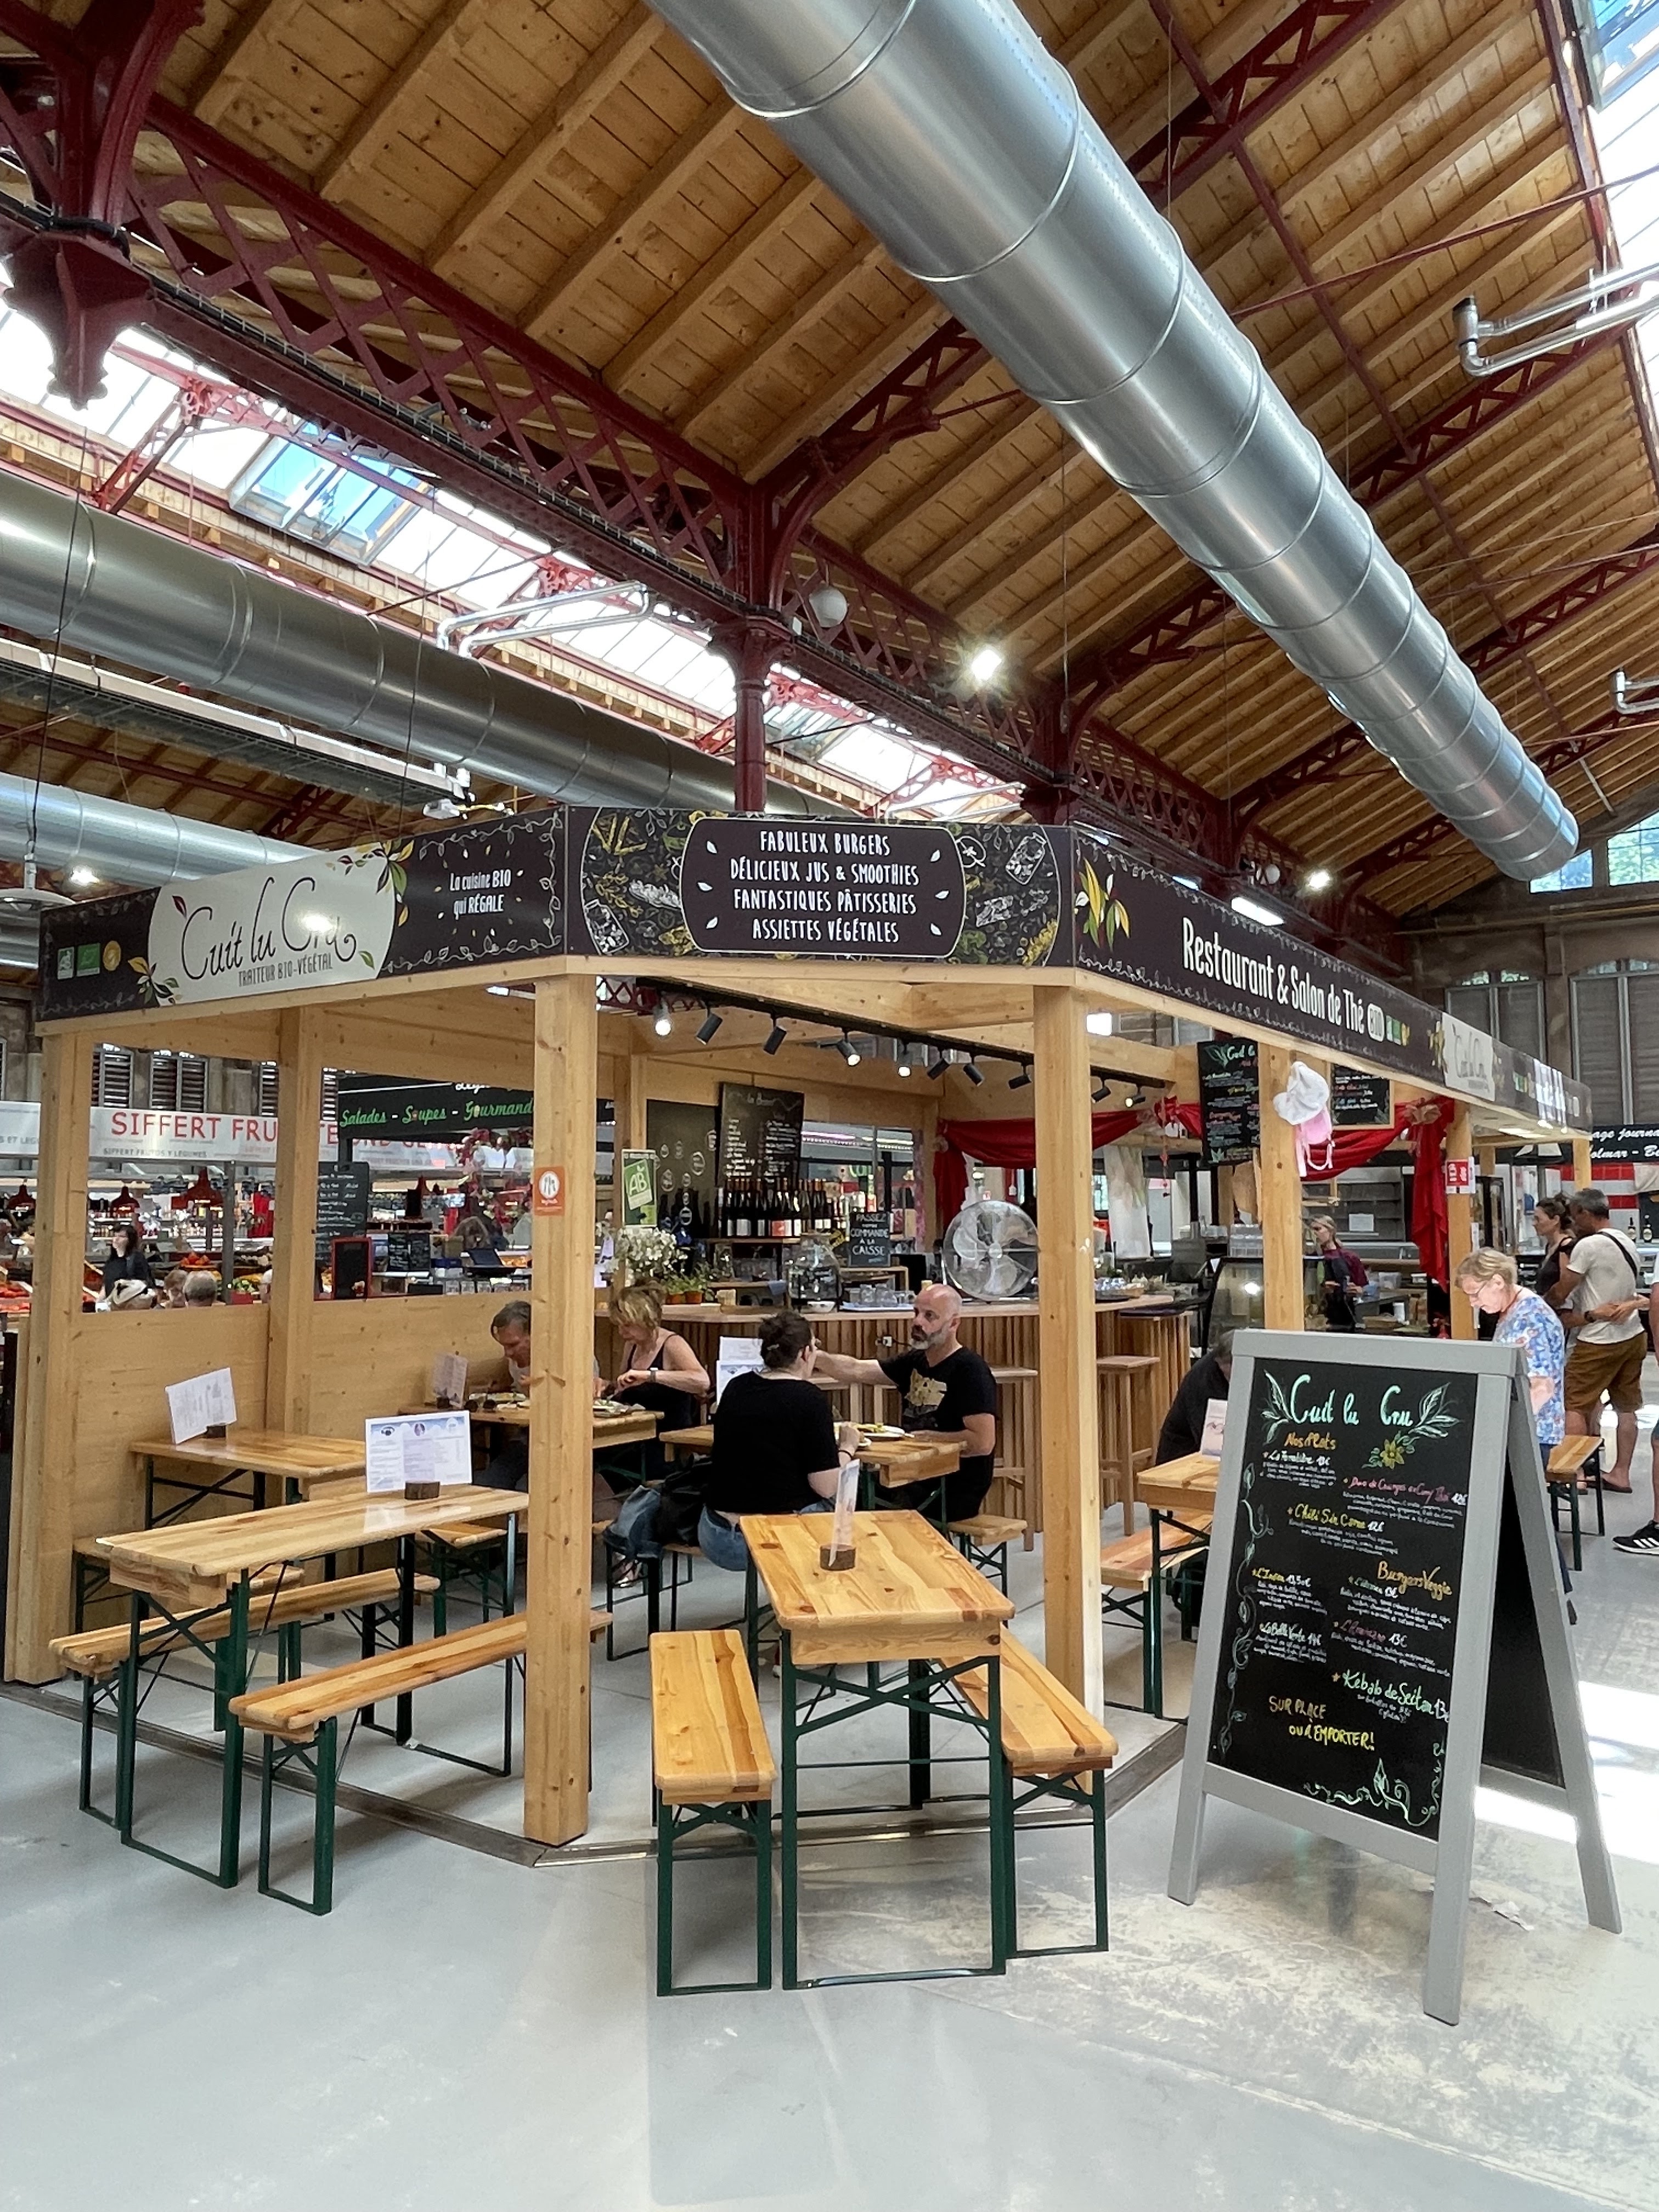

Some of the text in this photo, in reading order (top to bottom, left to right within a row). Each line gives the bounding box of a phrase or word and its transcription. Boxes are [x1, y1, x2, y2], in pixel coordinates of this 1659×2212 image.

[760, 830, 890, 856] FABULEUX BURGERS
[450, 869, 511, 891] La cuisine BIO
[731, 856, 919, 885] DÉLICIEUX JUS & SMOOTHIES
[453, 893, 505, 921] qui RÉGALE
[733, 888, 917, 915] FANTASTIQUES PÂTISSERIES
[181, 906, 243, 980] Cuit
[251, 876, 276, 963] lu
[753, 917, 899, 943] ASSIETTES VÉGÉTALES
[239, 964, 275, 987] TRAITEUR
[1182, 916, 1274, 1001] Restaurant
[1277, 963, 1289, 1005] &
[1290, 965, 1326, 1020] Salon
[1327, 983, 1342, 1026] de
[1342, 988, 1365, 1035] Thé
[111, 1111, 222, 1139] SIFFERT
[339, 1107, 387, 1127] Salades
[402, 1105, 447, 1125] Soupes
[464, 1097, 533, 1121] Gourmand
[1589, 1144, 1628, 1159] olmar
[851, 1245, 885, 1256] CAISSE
[1342, 1669, 1383, 1695] Kebab
[1385, 1683, 1398, 1699] de
